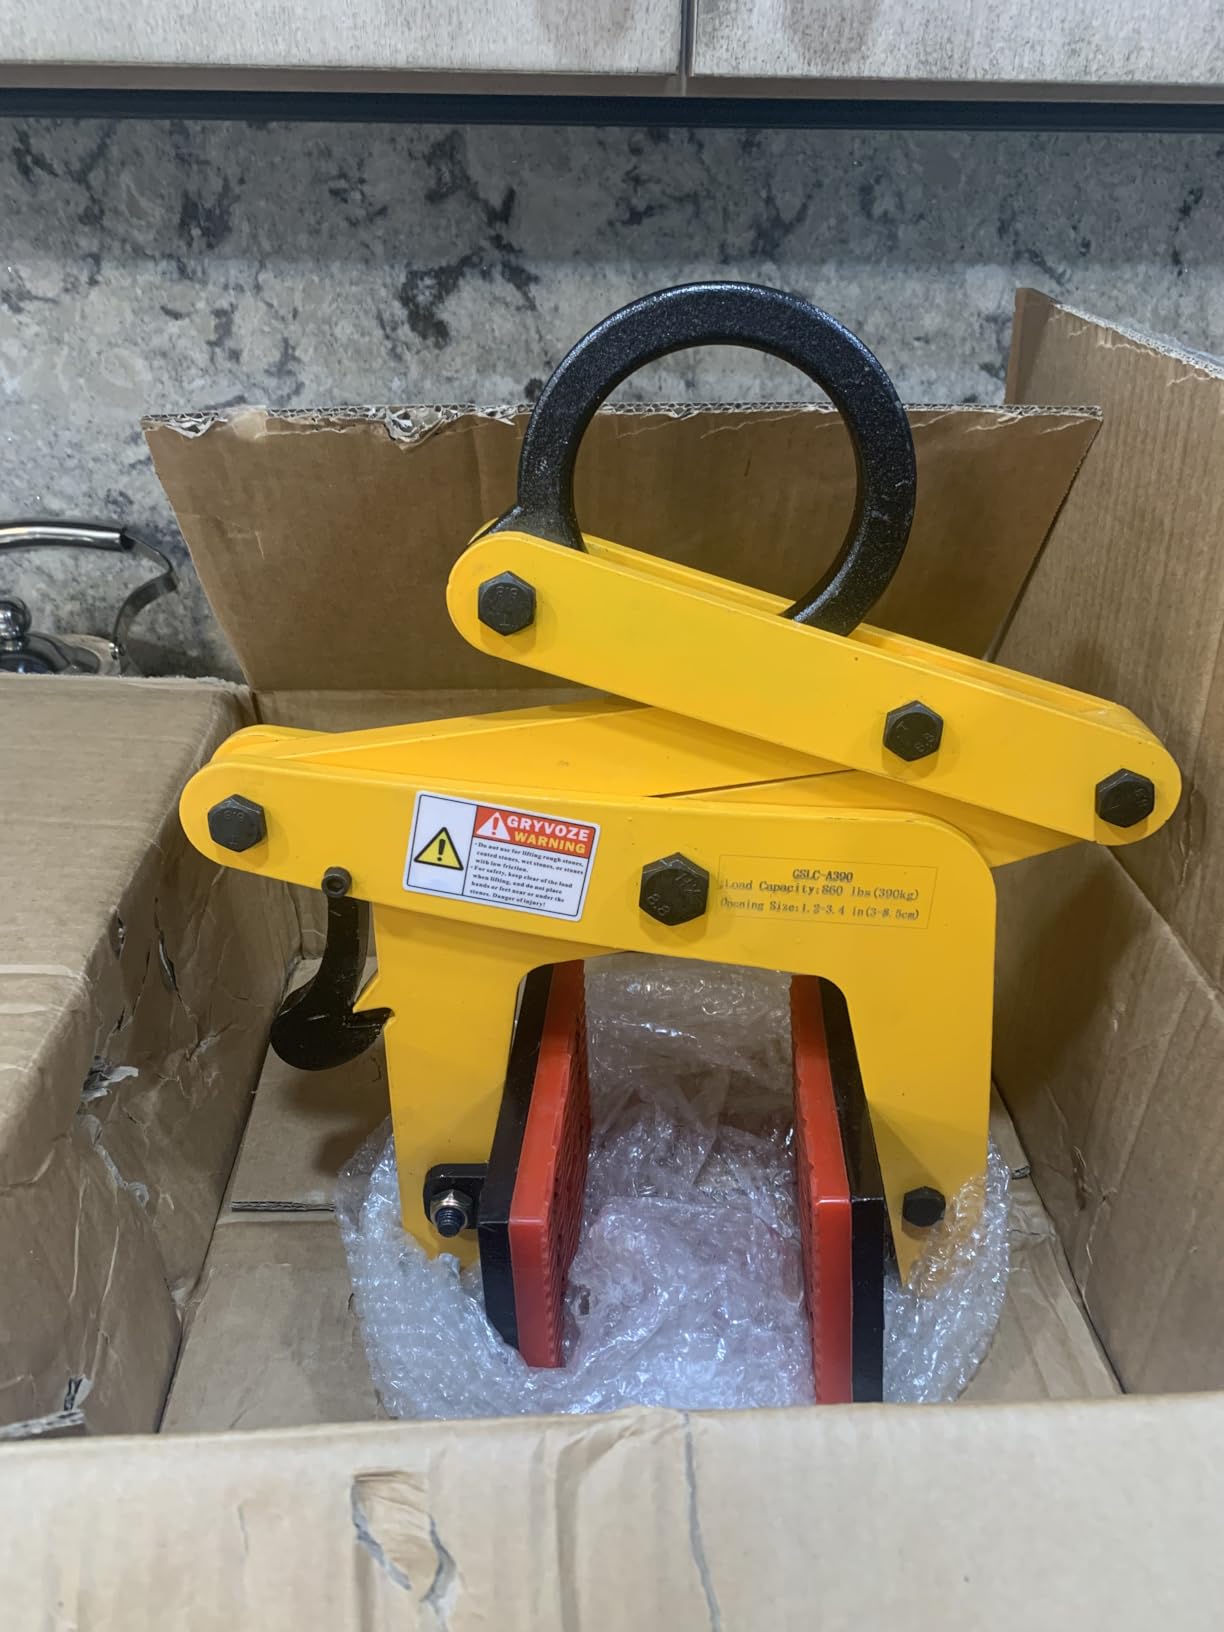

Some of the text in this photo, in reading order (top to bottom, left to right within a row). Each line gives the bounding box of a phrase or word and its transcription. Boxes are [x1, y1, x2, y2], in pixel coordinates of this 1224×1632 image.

[507, 815, 590, 842] GRYVOZE
[514, 831, 585, 854] WARNING
[476, 850, 497, 858] coated
[498, 855, 519, 863] stones,
[533, 861, 554, 869] stones,
[542, 854, 561, 862] rough
[562, 858, 584, 866] stones,
[486, 868, 506, 876] safety,
[502, 863, 528, 872] friction.
[490, 876, 511, 885] lifting,
[792, 869, 854, 882] GSLC-A390
[469, 888, 491, 896] stones.
[492, 893, 514, 901] Danger
